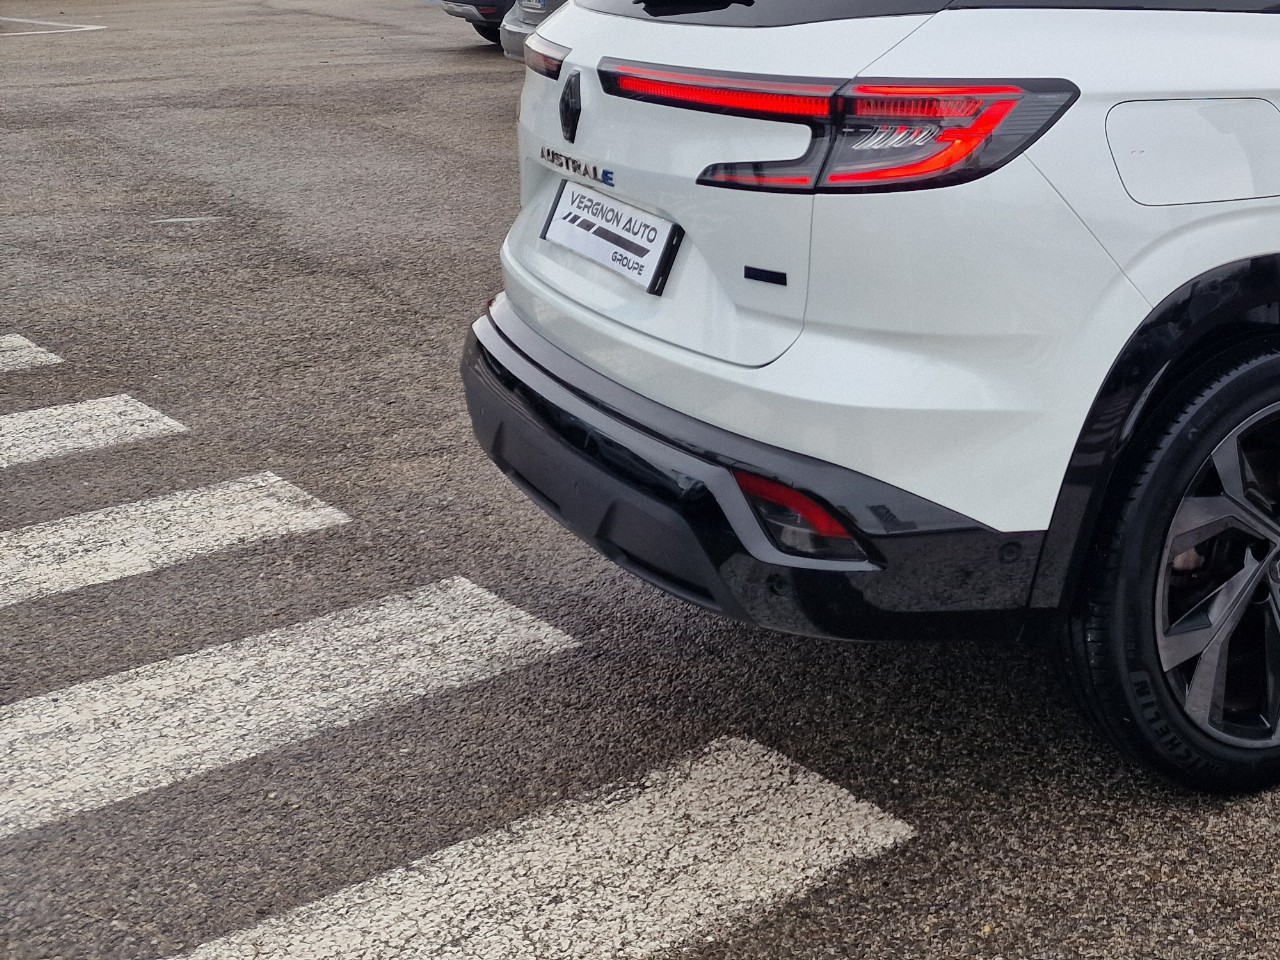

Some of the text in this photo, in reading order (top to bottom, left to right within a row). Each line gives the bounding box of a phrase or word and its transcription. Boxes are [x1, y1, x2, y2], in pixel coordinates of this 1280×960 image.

[570, 191, 658, 244] VERGNON AUTO
[611, 250, 646, 276] GROUPE
